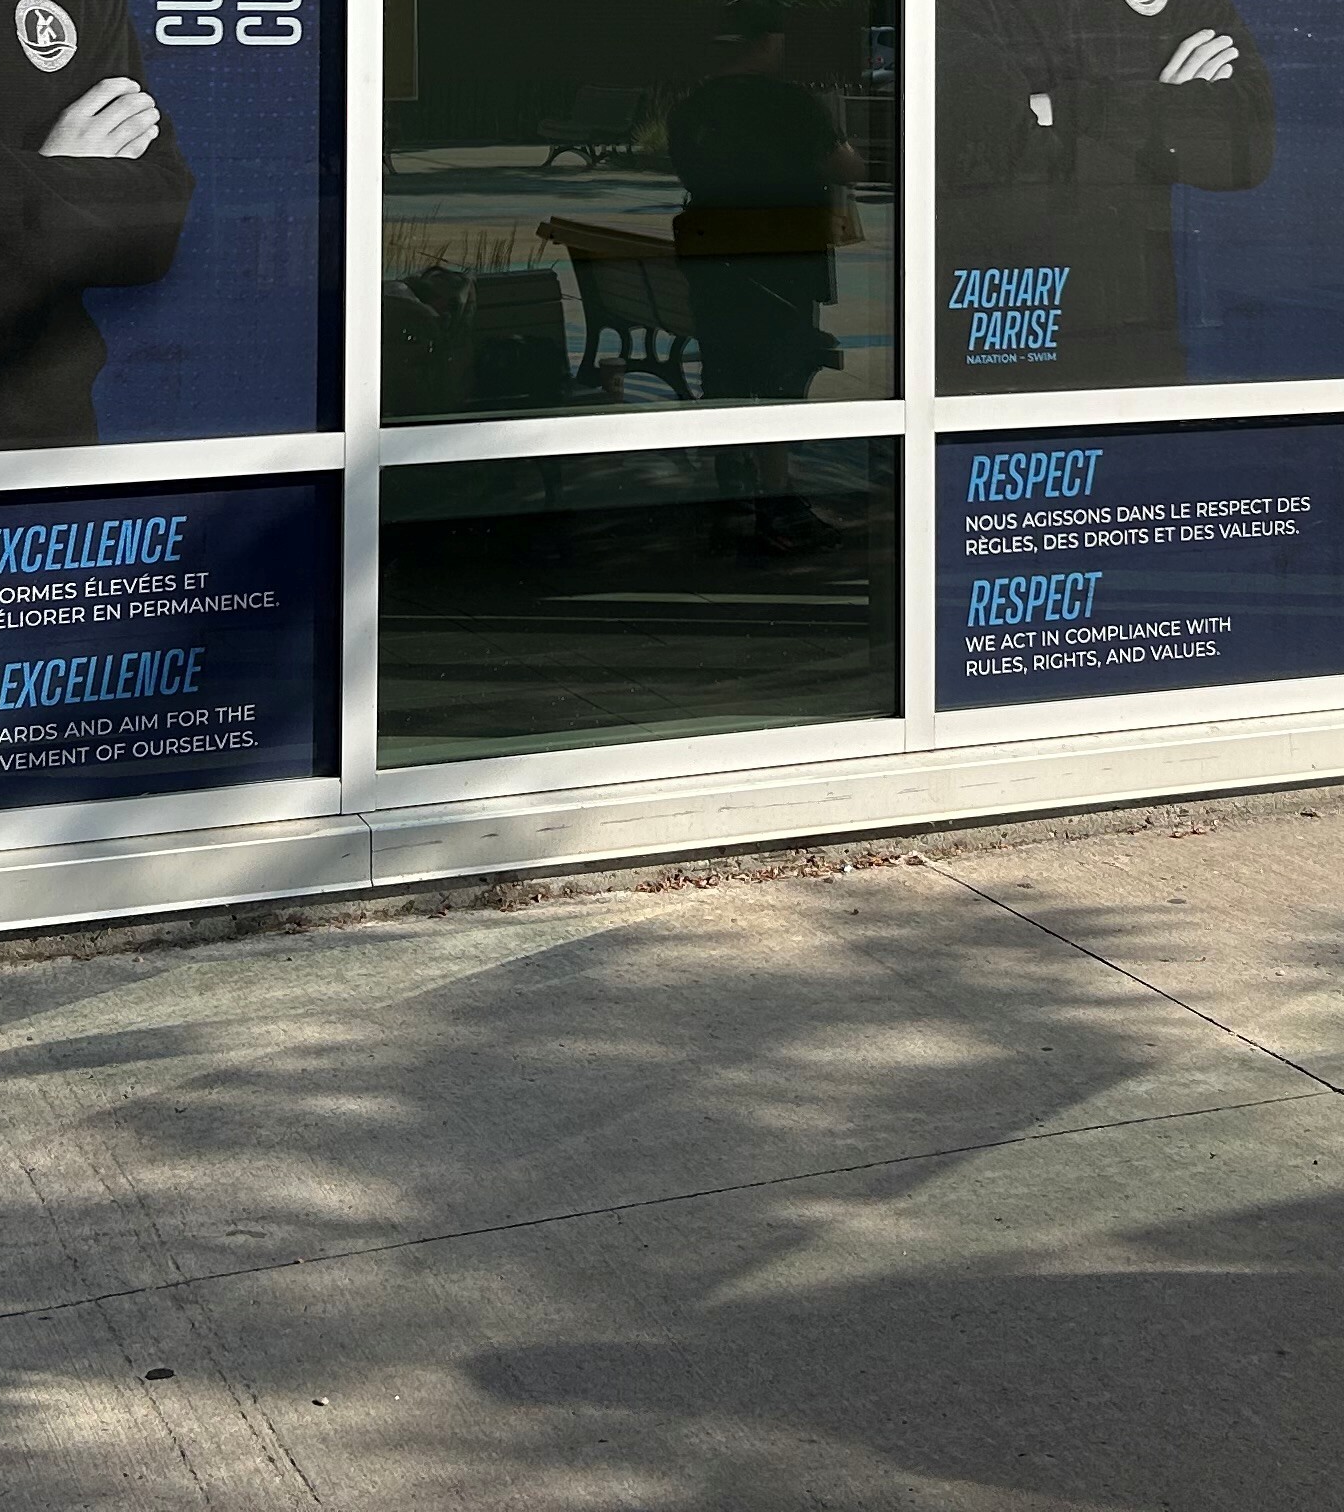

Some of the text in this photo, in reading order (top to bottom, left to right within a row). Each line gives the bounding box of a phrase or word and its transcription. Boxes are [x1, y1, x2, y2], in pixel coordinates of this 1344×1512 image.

[949, 267, 1070, 309] ZACHARY
[968, 310, 1062, 351] PARISE
[966, 353, 1017, 364] NATATION
[1027, 352, 1056, 362] SWIM
[967, 449, 1103, 502] RESPECT
[965, 496, 1310, 532] NOUS AGISSONS DANS LE RESPECT DES
[965, 520, 1299, 555] RÈGLES, DES DROITS ET DES VALEURS.
[84, 573, 176, 597] ÉLEVÉES
[184, 572, 208, 589] ET
[967, 572, 1102, 627] RESPECT
[93, 603, 120, 621] EN
[129, 591, 279, 618] PERMANENCE.
[965, 616, 1231, 652] WE ACT IN COMPLIANCE WITH
[966, 641, 1220, 676] RULES, RIGHTS, AND VALUES.
[63, 718, 112, 737] AND
[118, 713, 157, 732] AIM
[166, 709, 208, 727] FOR
[215, 704, 255, 723] THE
[96, 743, 125, 760] OF
[132, 731, 258, 757] OURSELVES.
